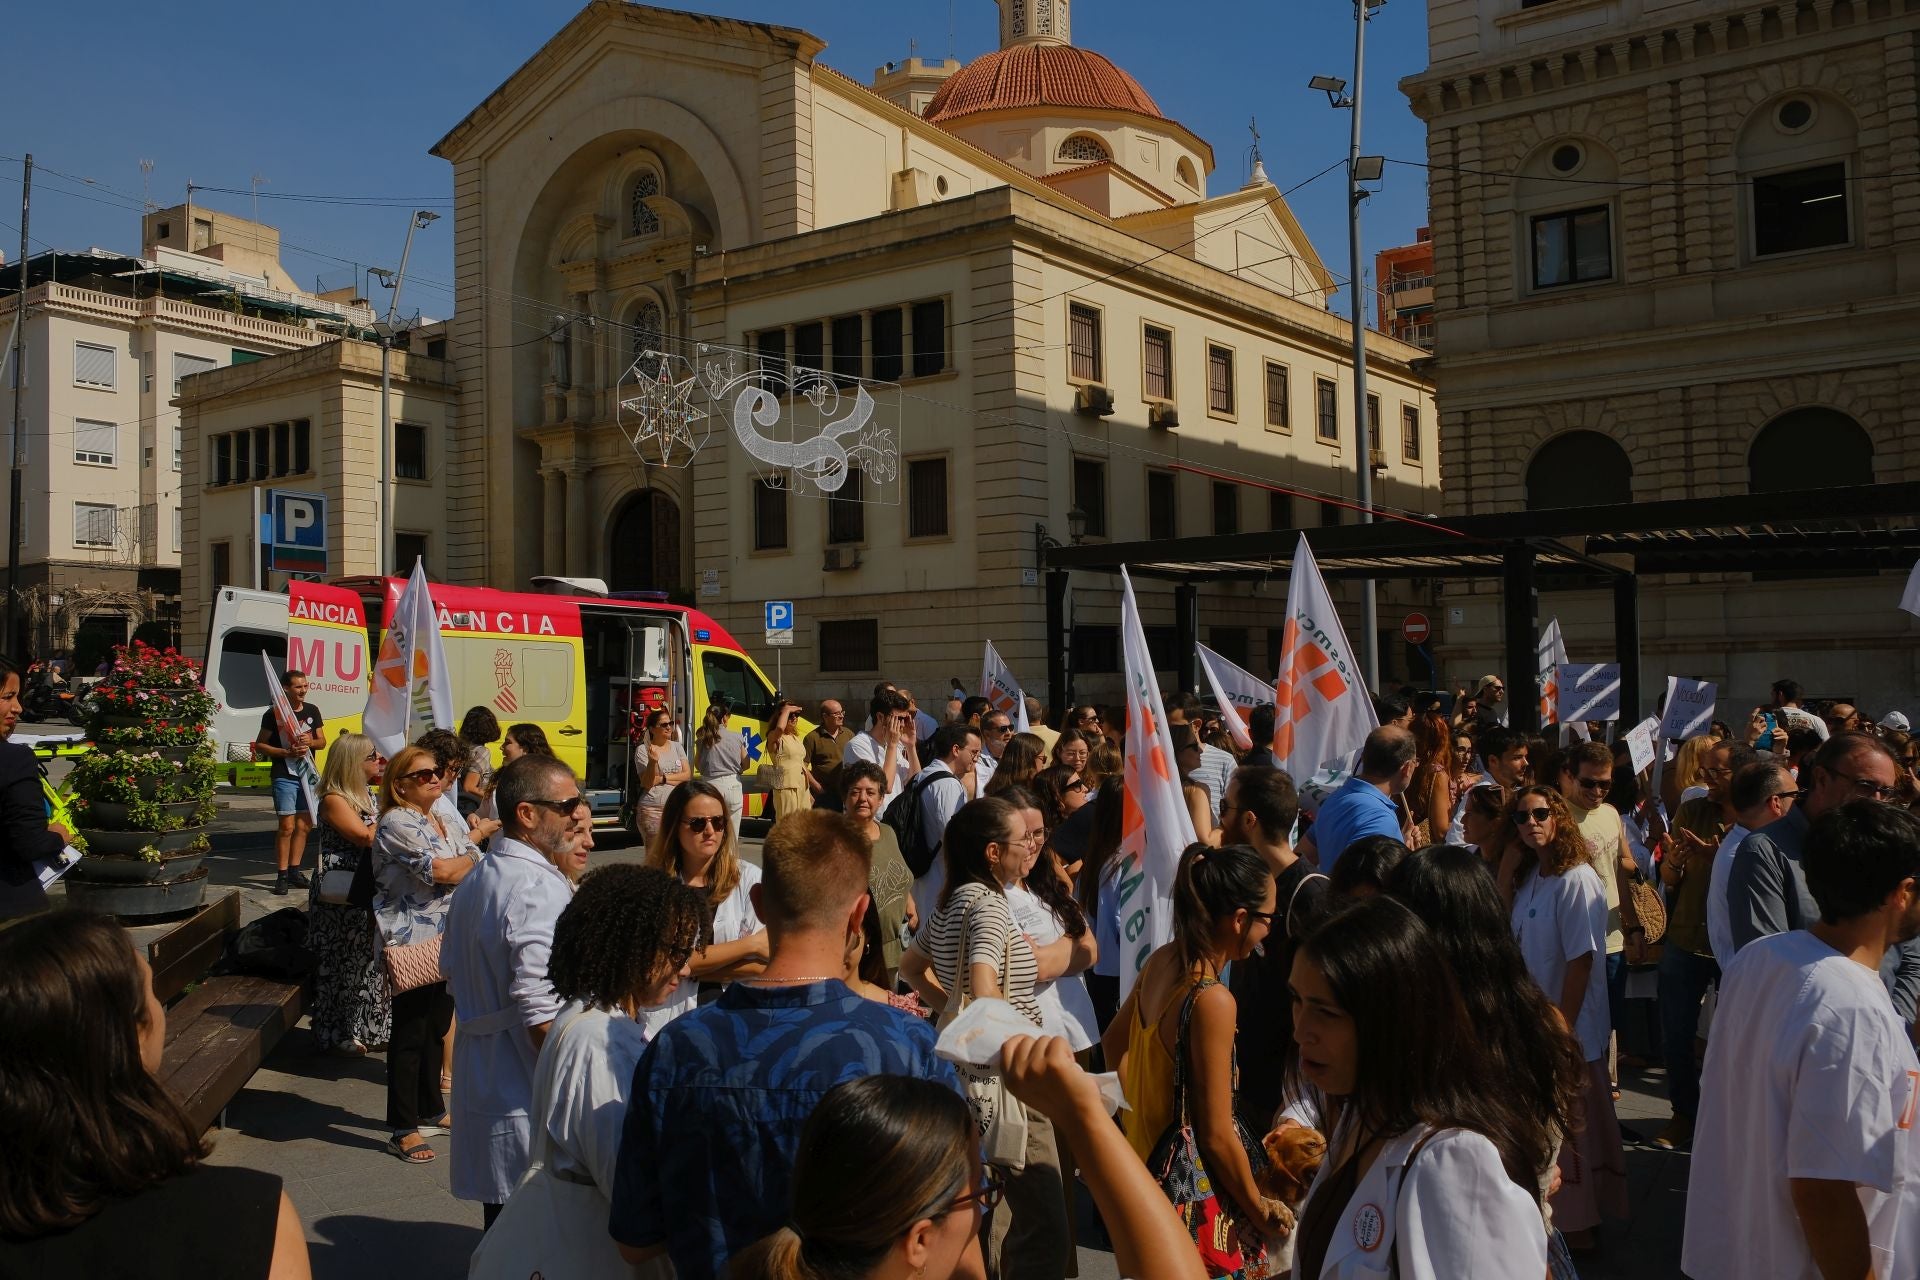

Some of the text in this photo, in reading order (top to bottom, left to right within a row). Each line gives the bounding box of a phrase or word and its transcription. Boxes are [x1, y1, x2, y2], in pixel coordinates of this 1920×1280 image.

[284, 498, 315, 542] P
[771, 605, 787, 627] P
[325, 683, 361, 695] URGENT
